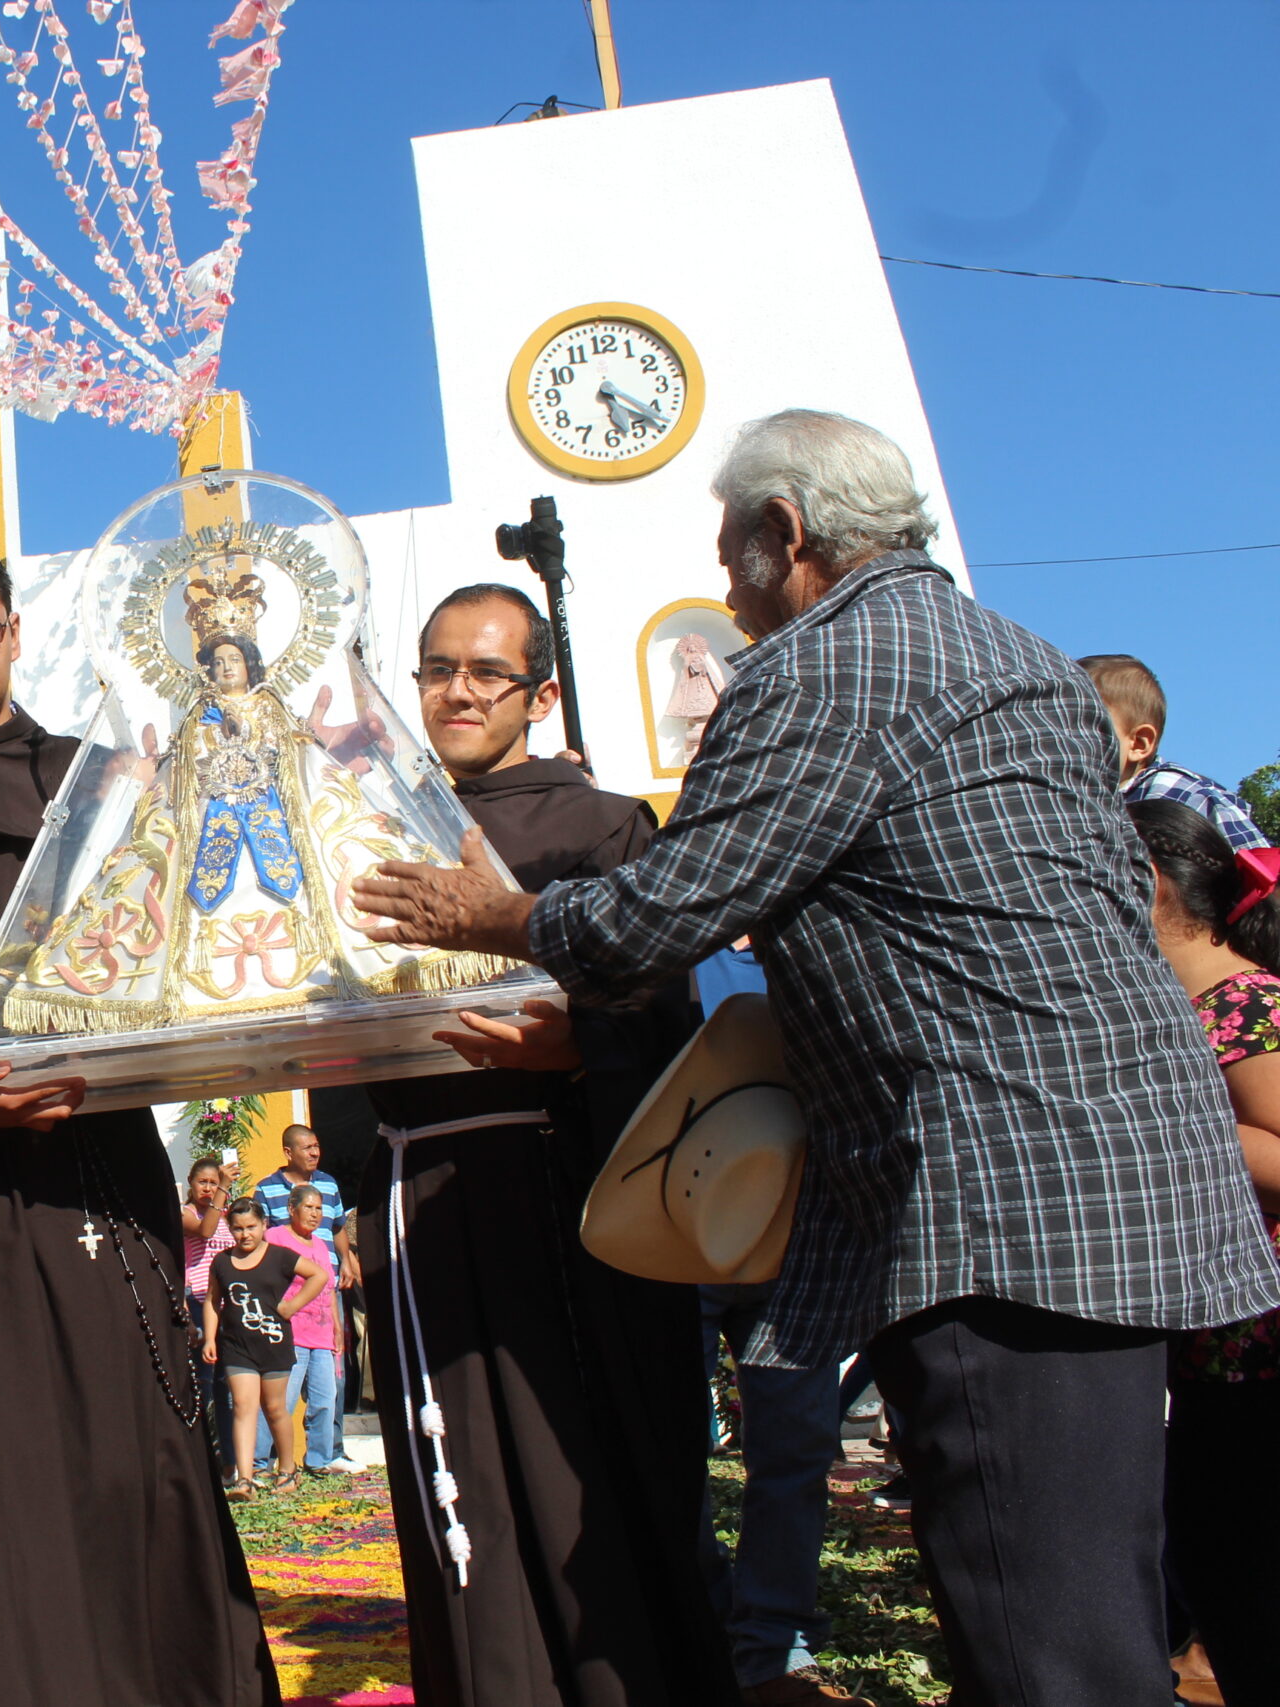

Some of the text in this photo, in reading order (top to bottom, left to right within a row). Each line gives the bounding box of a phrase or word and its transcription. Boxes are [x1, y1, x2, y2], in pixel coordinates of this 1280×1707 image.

[590, 334, 618, 355] 12
[623, 339, 635, 358] 1
[566, 344, 588, 365] 11
[639, 354, 658, 374] 2
[549, 365, 575, 386] 10
[655, 375, 669, 393] 3
[544, 388, 561, 407] 9
[555, 409, 571, 428] 8
[575, 424, 593, 444] 7
[604, 428, 621, 447] 6
[631, 419, 647, 438] 5
